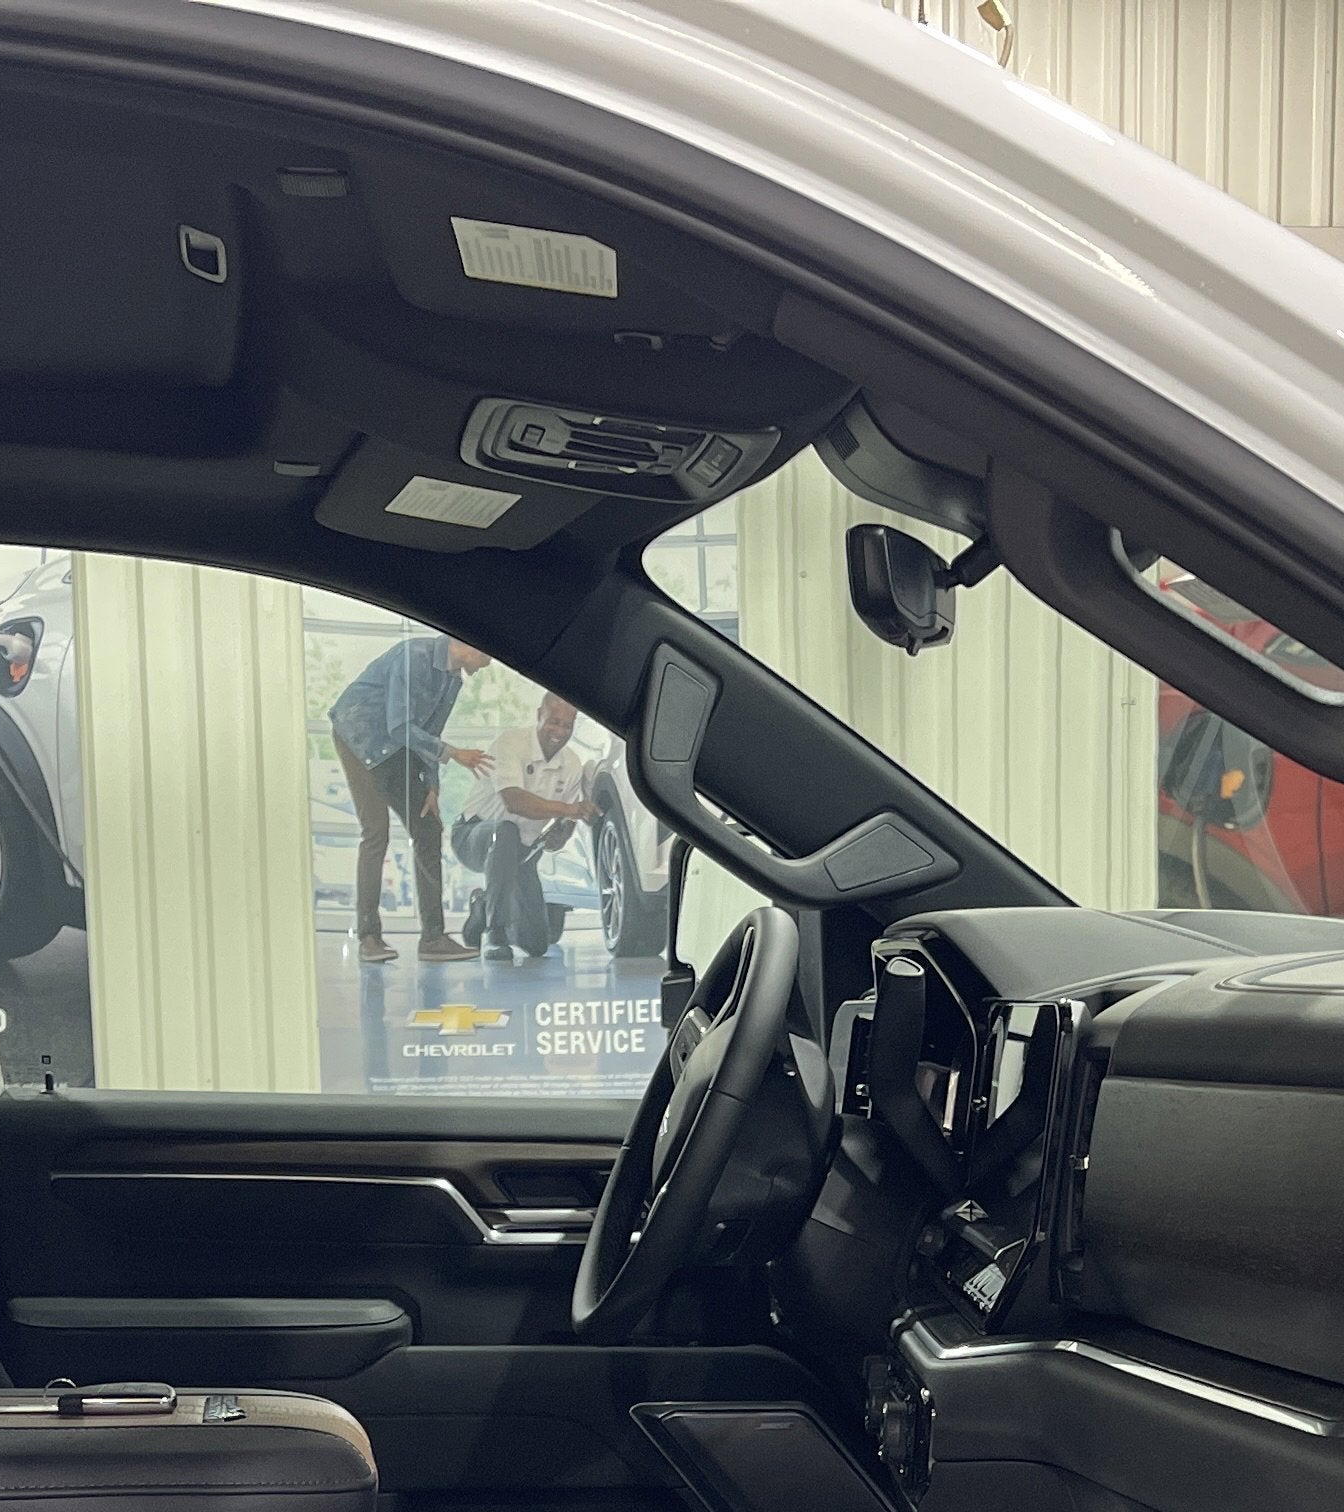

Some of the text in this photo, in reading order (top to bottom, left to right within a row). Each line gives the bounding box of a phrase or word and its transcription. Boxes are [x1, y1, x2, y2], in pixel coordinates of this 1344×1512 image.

[535, 999, 662, 1026] CERTIFIED
[403, 1043, 516, 1057] CHEVROLET
[536, 1029, 646, 1056] SERVICE
